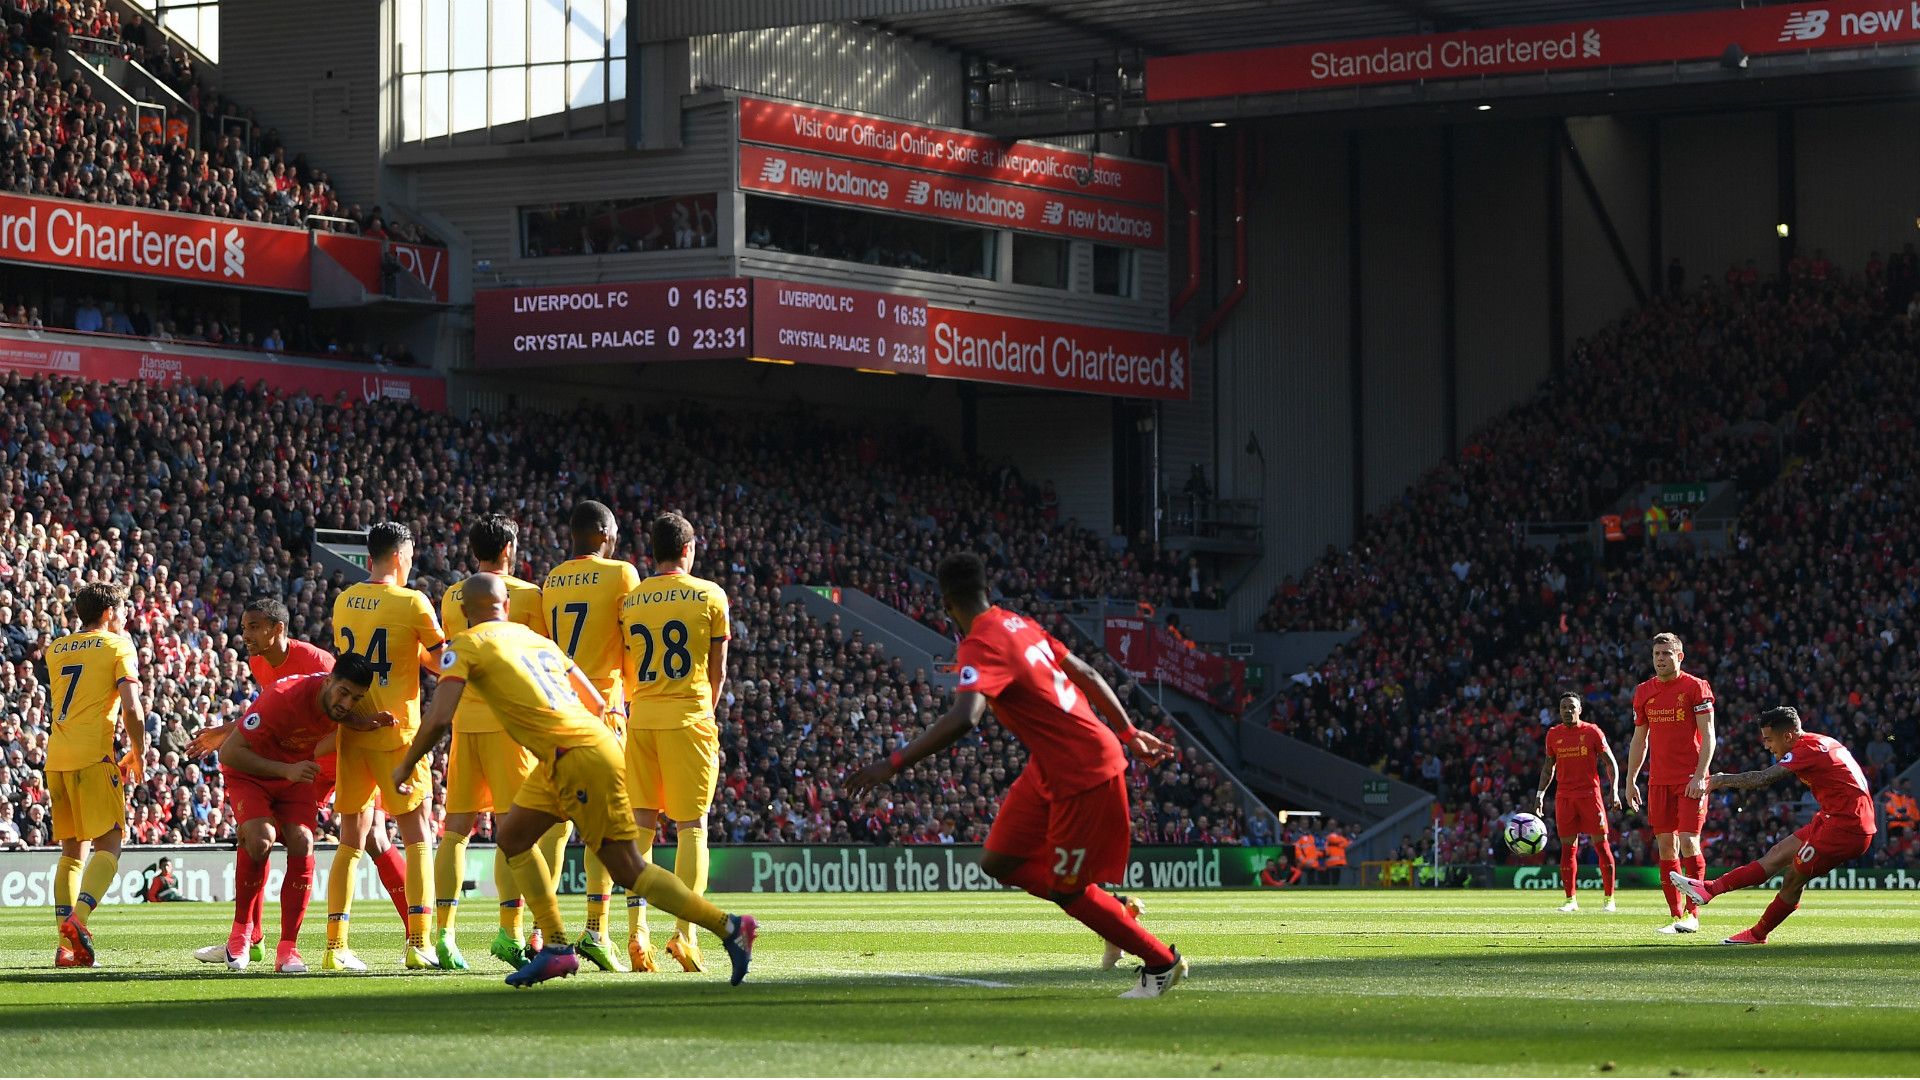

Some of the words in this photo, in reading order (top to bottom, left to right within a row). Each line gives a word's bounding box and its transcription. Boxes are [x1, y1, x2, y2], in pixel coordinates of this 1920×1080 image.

[1840, 8, 1904, 36] new
[1310, 44, 1432, 79] Standard
[1440, 32, 1577, 68] Chartered
[792, 113, 822, 139] Visit
[825, 124, 849, 142] our
[851, 123, 897, 151] Official
[900, 132, 944, 158] Online
[946, 139, 978, 166] Store
[982, 150, 994, 166] at
[791, 167, 824, 190] new
[826, 167, 889, 200] balance
[934, 189, 964, 210] new
[966, 189, 1025, 220] balance
[1068, 209, 1095, 230] new
[1098, 207, 1151, 238] balance
[47, 207, 216, 273] Chartered
[513, 292, 604, 313] LIVERPOOL
[607, 291, 629, 309] FC
[667, 286, 680, 308] 0
[692, 287, 748, 310] 16:53
[779, 289, 838, 312] LIVERPOOL
[840, 296, 854, 313] FC
[877, 299, 886, 319] 0
[893, 305, 927, 327] 16:53
[513, 333, 588, 352] CRYSTAL
[591, 329, 656, 348] PALACE
[667, 326, 680, 347] 0
[692, 327, 747, 349] 23:31
[779, 328, 827, 349] CRYSTAL
[829, 334, 870, 353] PALACE
[877, 337, 886, 357] 0
[893, 343, 926, 365] 23:31
[934, 322, 1045, 375] Standard
[1052, 336, 1165, 386] Chartered
[1663, 493, 1684, 502] EXIT
[346, 597, 380, 610] KELLY
[54, 638, 103, 654] CABAYE
[552, 602, 588, 660] 17
[629, 619, 692, 682] 28
[57, 664, 84, 722] 7
[1648, 708, 1675, 716] Standard
[1053, 847, 1086, 876] 27
[1150, 848, 1222, 888] world
[1797, 841, 1816, 863] 10
[894, 848, 939, 892] the
[945, 848, 1003, 890] bes
